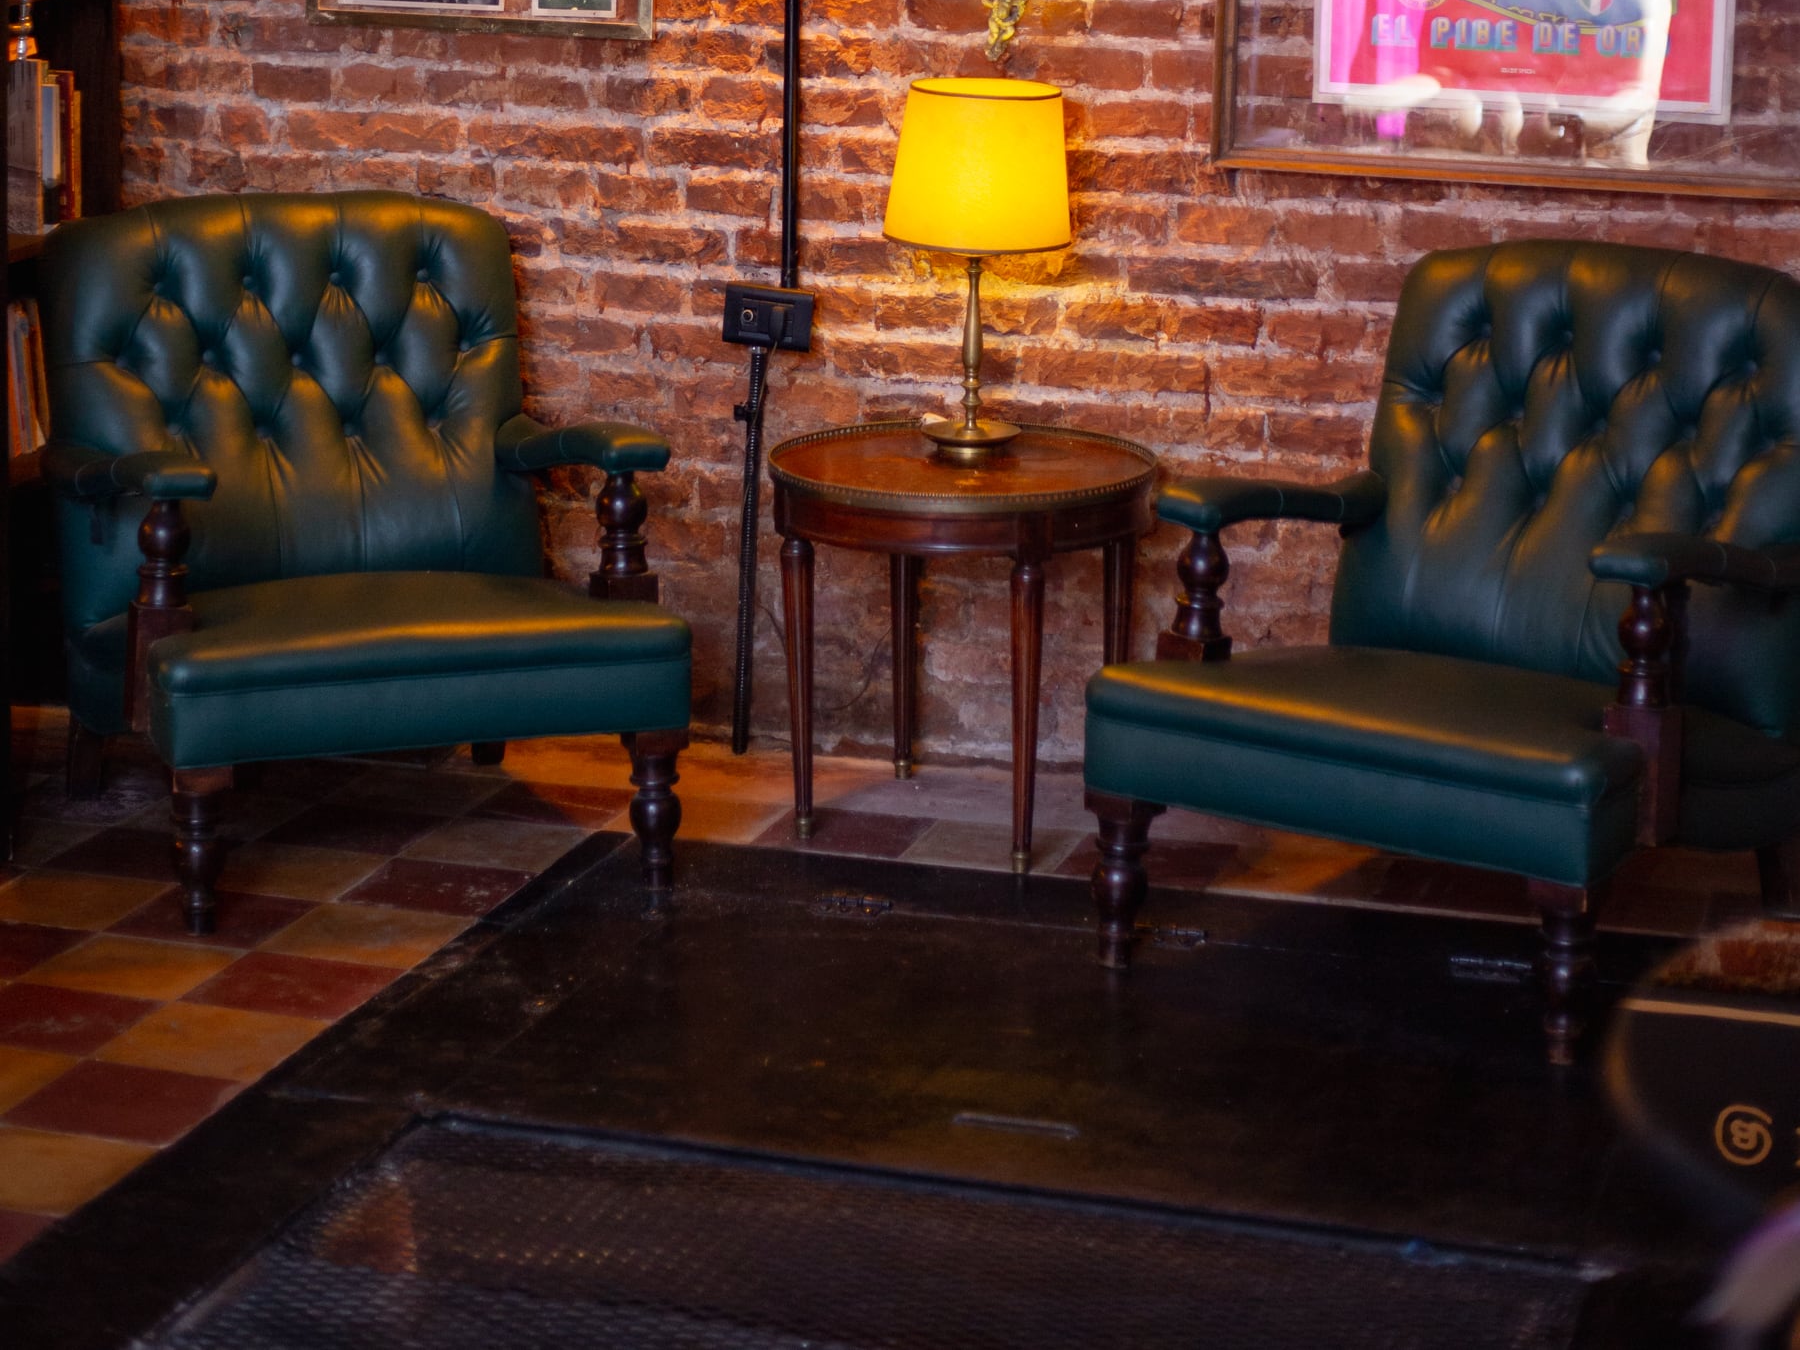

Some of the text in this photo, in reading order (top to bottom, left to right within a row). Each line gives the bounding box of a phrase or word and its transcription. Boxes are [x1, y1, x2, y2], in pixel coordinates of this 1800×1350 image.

[1372, 13, 1671, 58] EL PIBE DE OR
